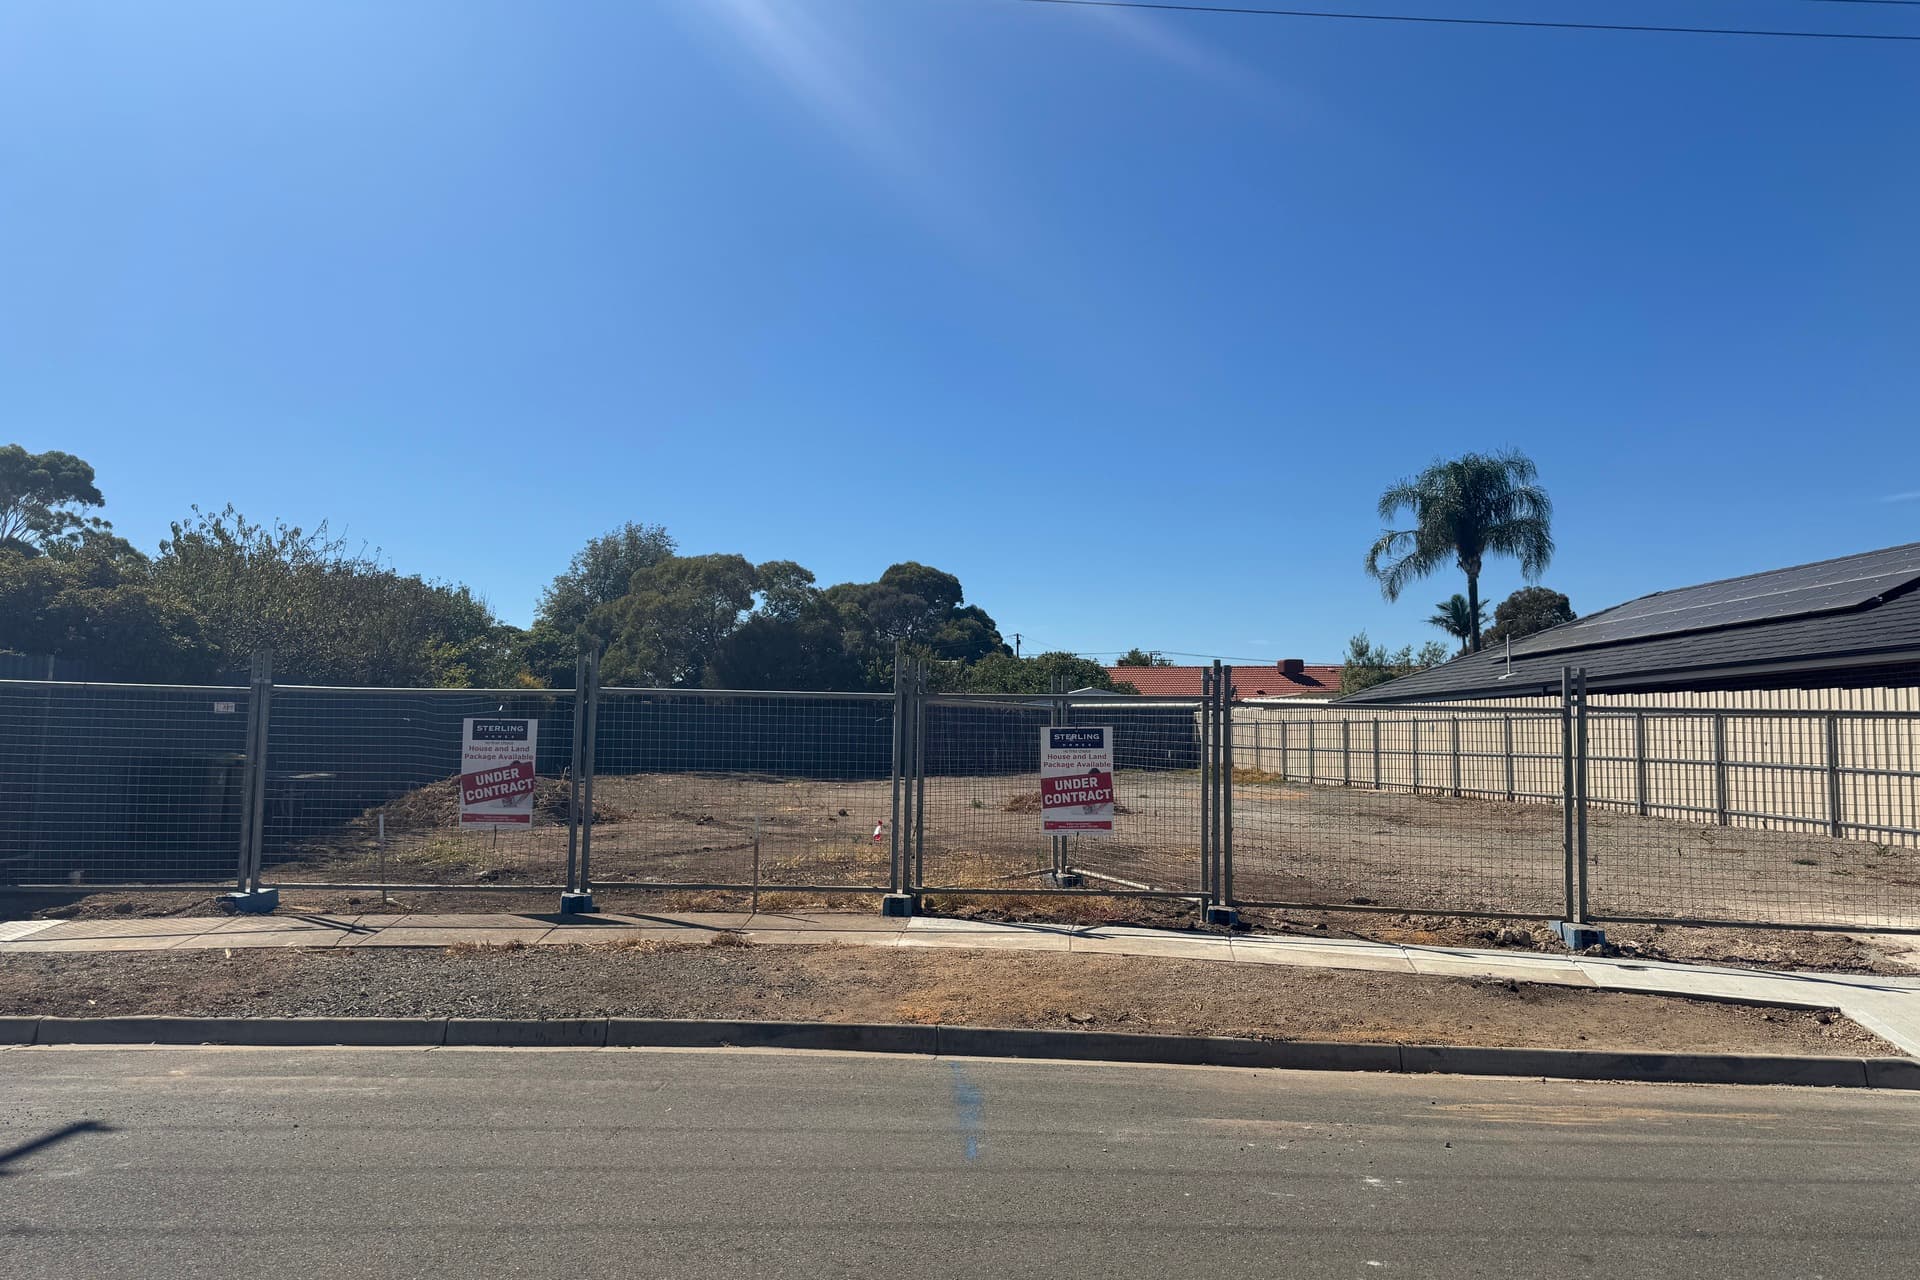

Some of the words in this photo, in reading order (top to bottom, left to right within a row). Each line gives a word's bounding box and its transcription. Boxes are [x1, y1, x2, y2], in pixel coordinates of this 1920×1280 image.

[464, 753, 497, 761] Package
[475, 767, 520, 786] UNDER
[1054, 777, 1098, 791] UNDER
[466, 778, 533, 801] CONTRACT
[1044, 788, 1111, 805] CONTRACT
